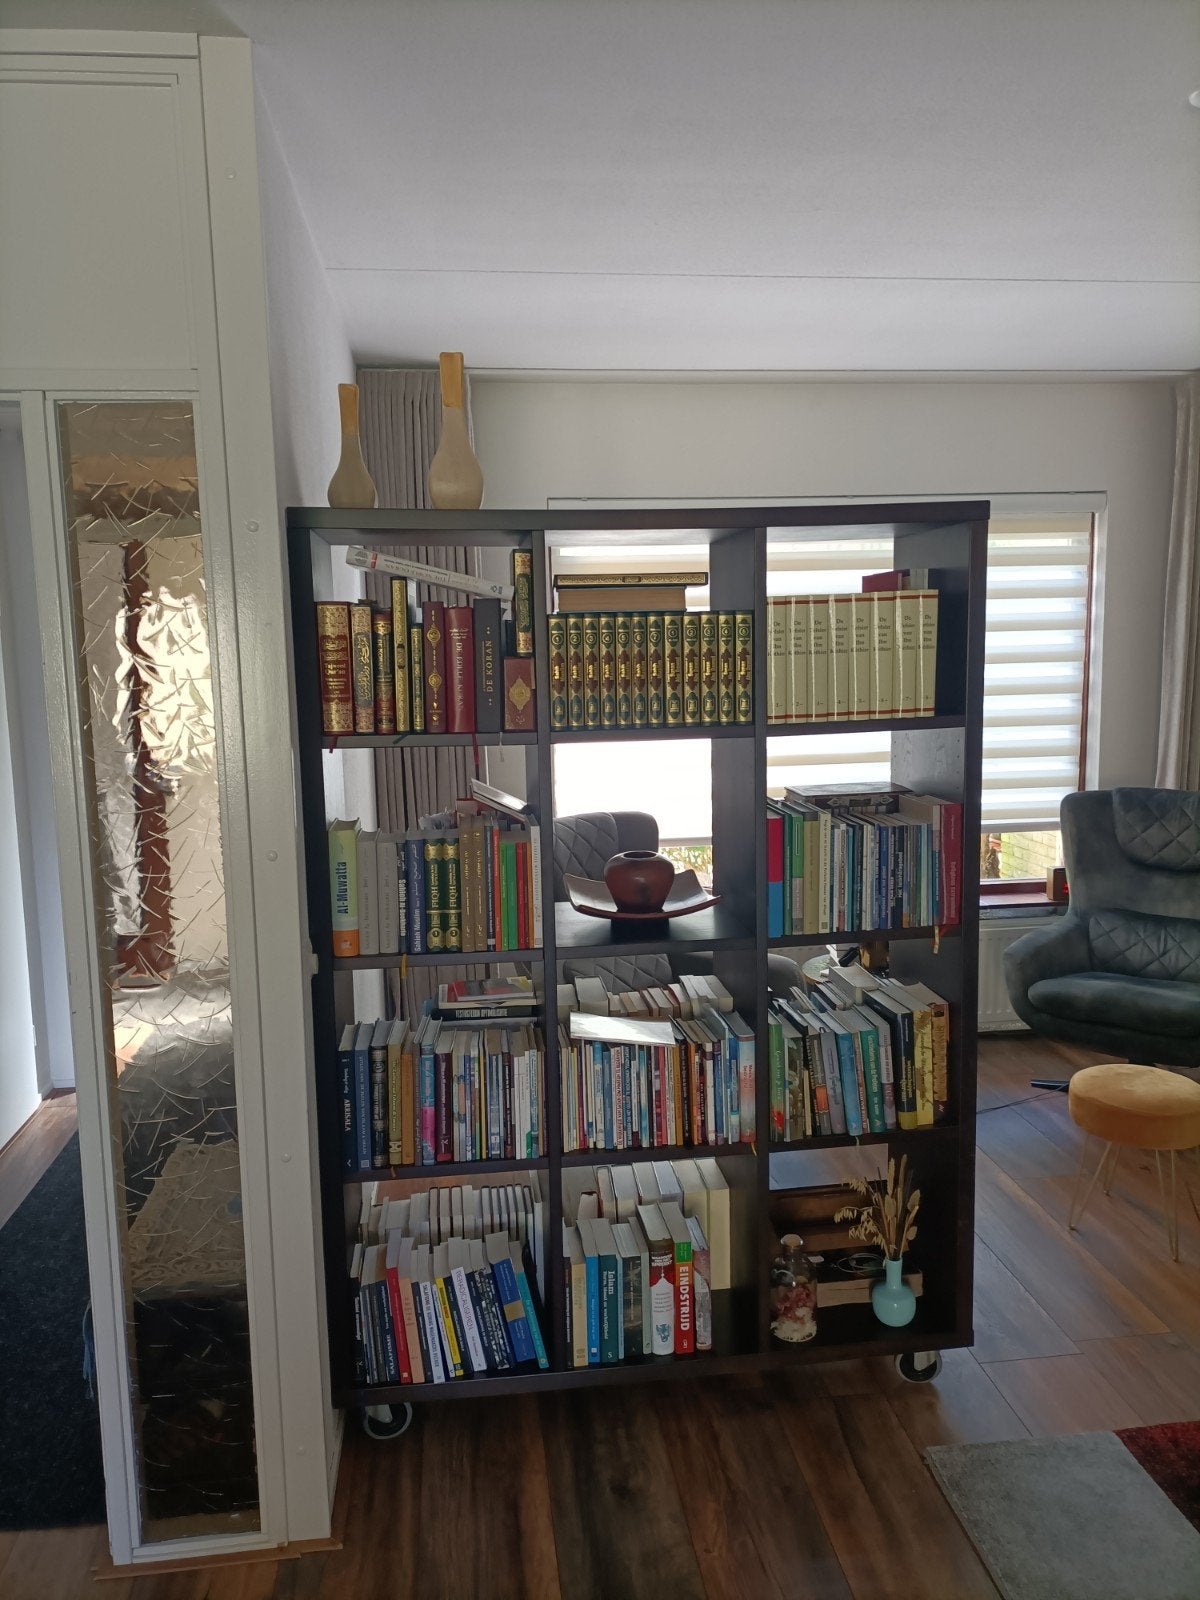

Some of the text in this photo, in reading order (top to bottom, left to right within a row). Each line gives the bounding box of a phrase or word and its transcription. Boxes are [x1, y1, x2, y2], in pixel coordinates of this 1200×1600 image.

[485, 640, 493, 692] DE KORAN
[336, 863, 350, 914] Al-Muwatta
[431, 887, 440, 909] FIQH
[449, 887, 458, 909] FIQH
[413, 909, 421, 931] Muslim
[343, 1099, 352, 1132] ARRISALA
[607, 1270, 616, 1295] Islam
[679, 1266, 690, 1331] EINDSTRIJD
[385, 1333, 395, 1374] SALAFISME
